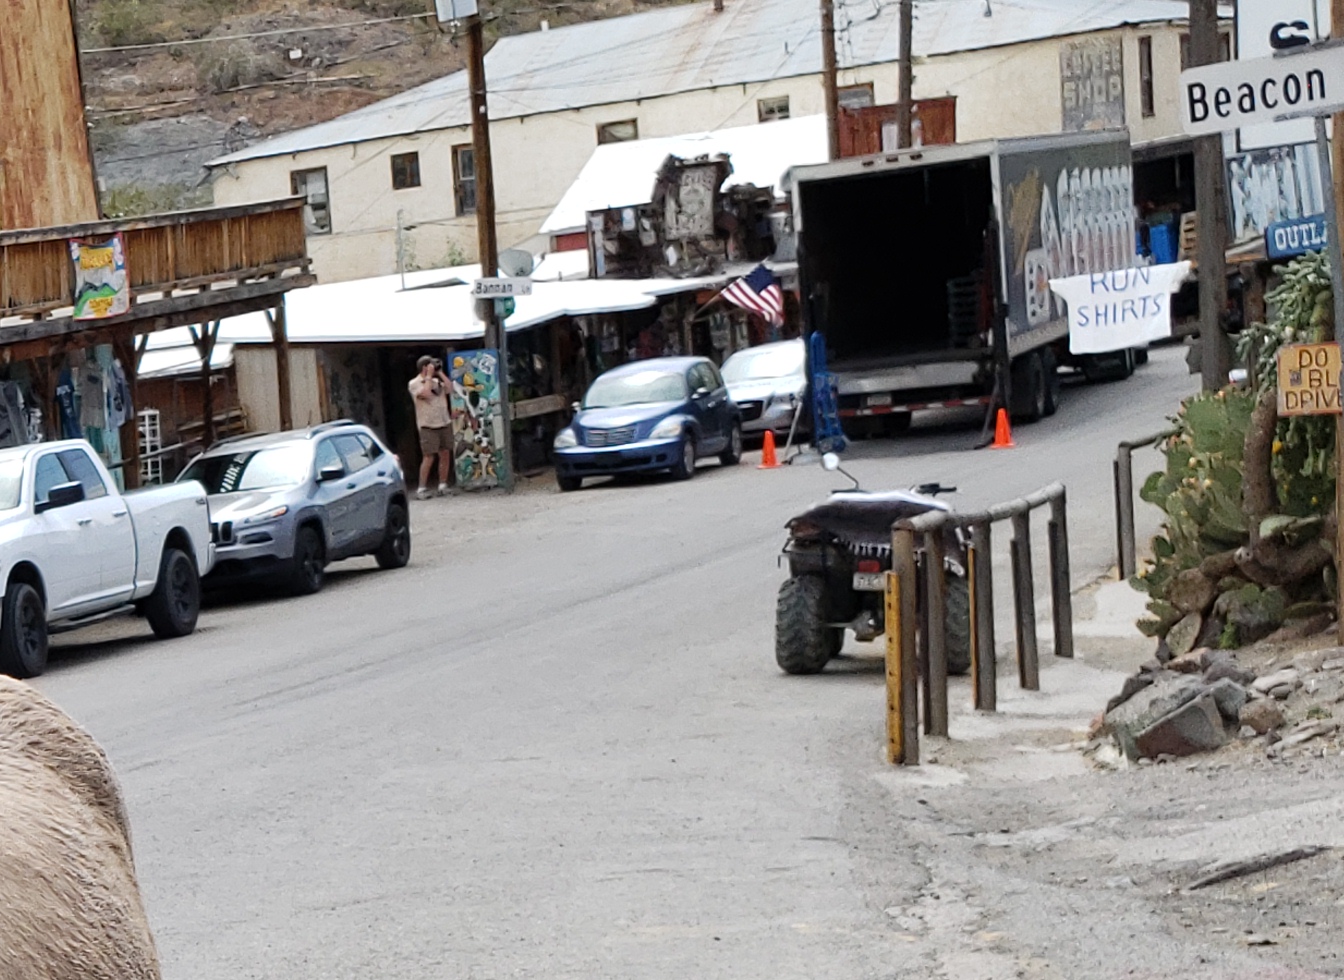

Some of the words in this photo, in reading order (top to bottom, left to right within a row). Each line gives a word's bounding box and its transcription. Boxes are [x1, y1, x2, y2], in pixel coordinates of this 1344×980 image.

[1188, 69, 1325, 123] Beacon
[1077, 293, 1163, 327] SHIRTS
[1299, 348, 1327, 368] DO
